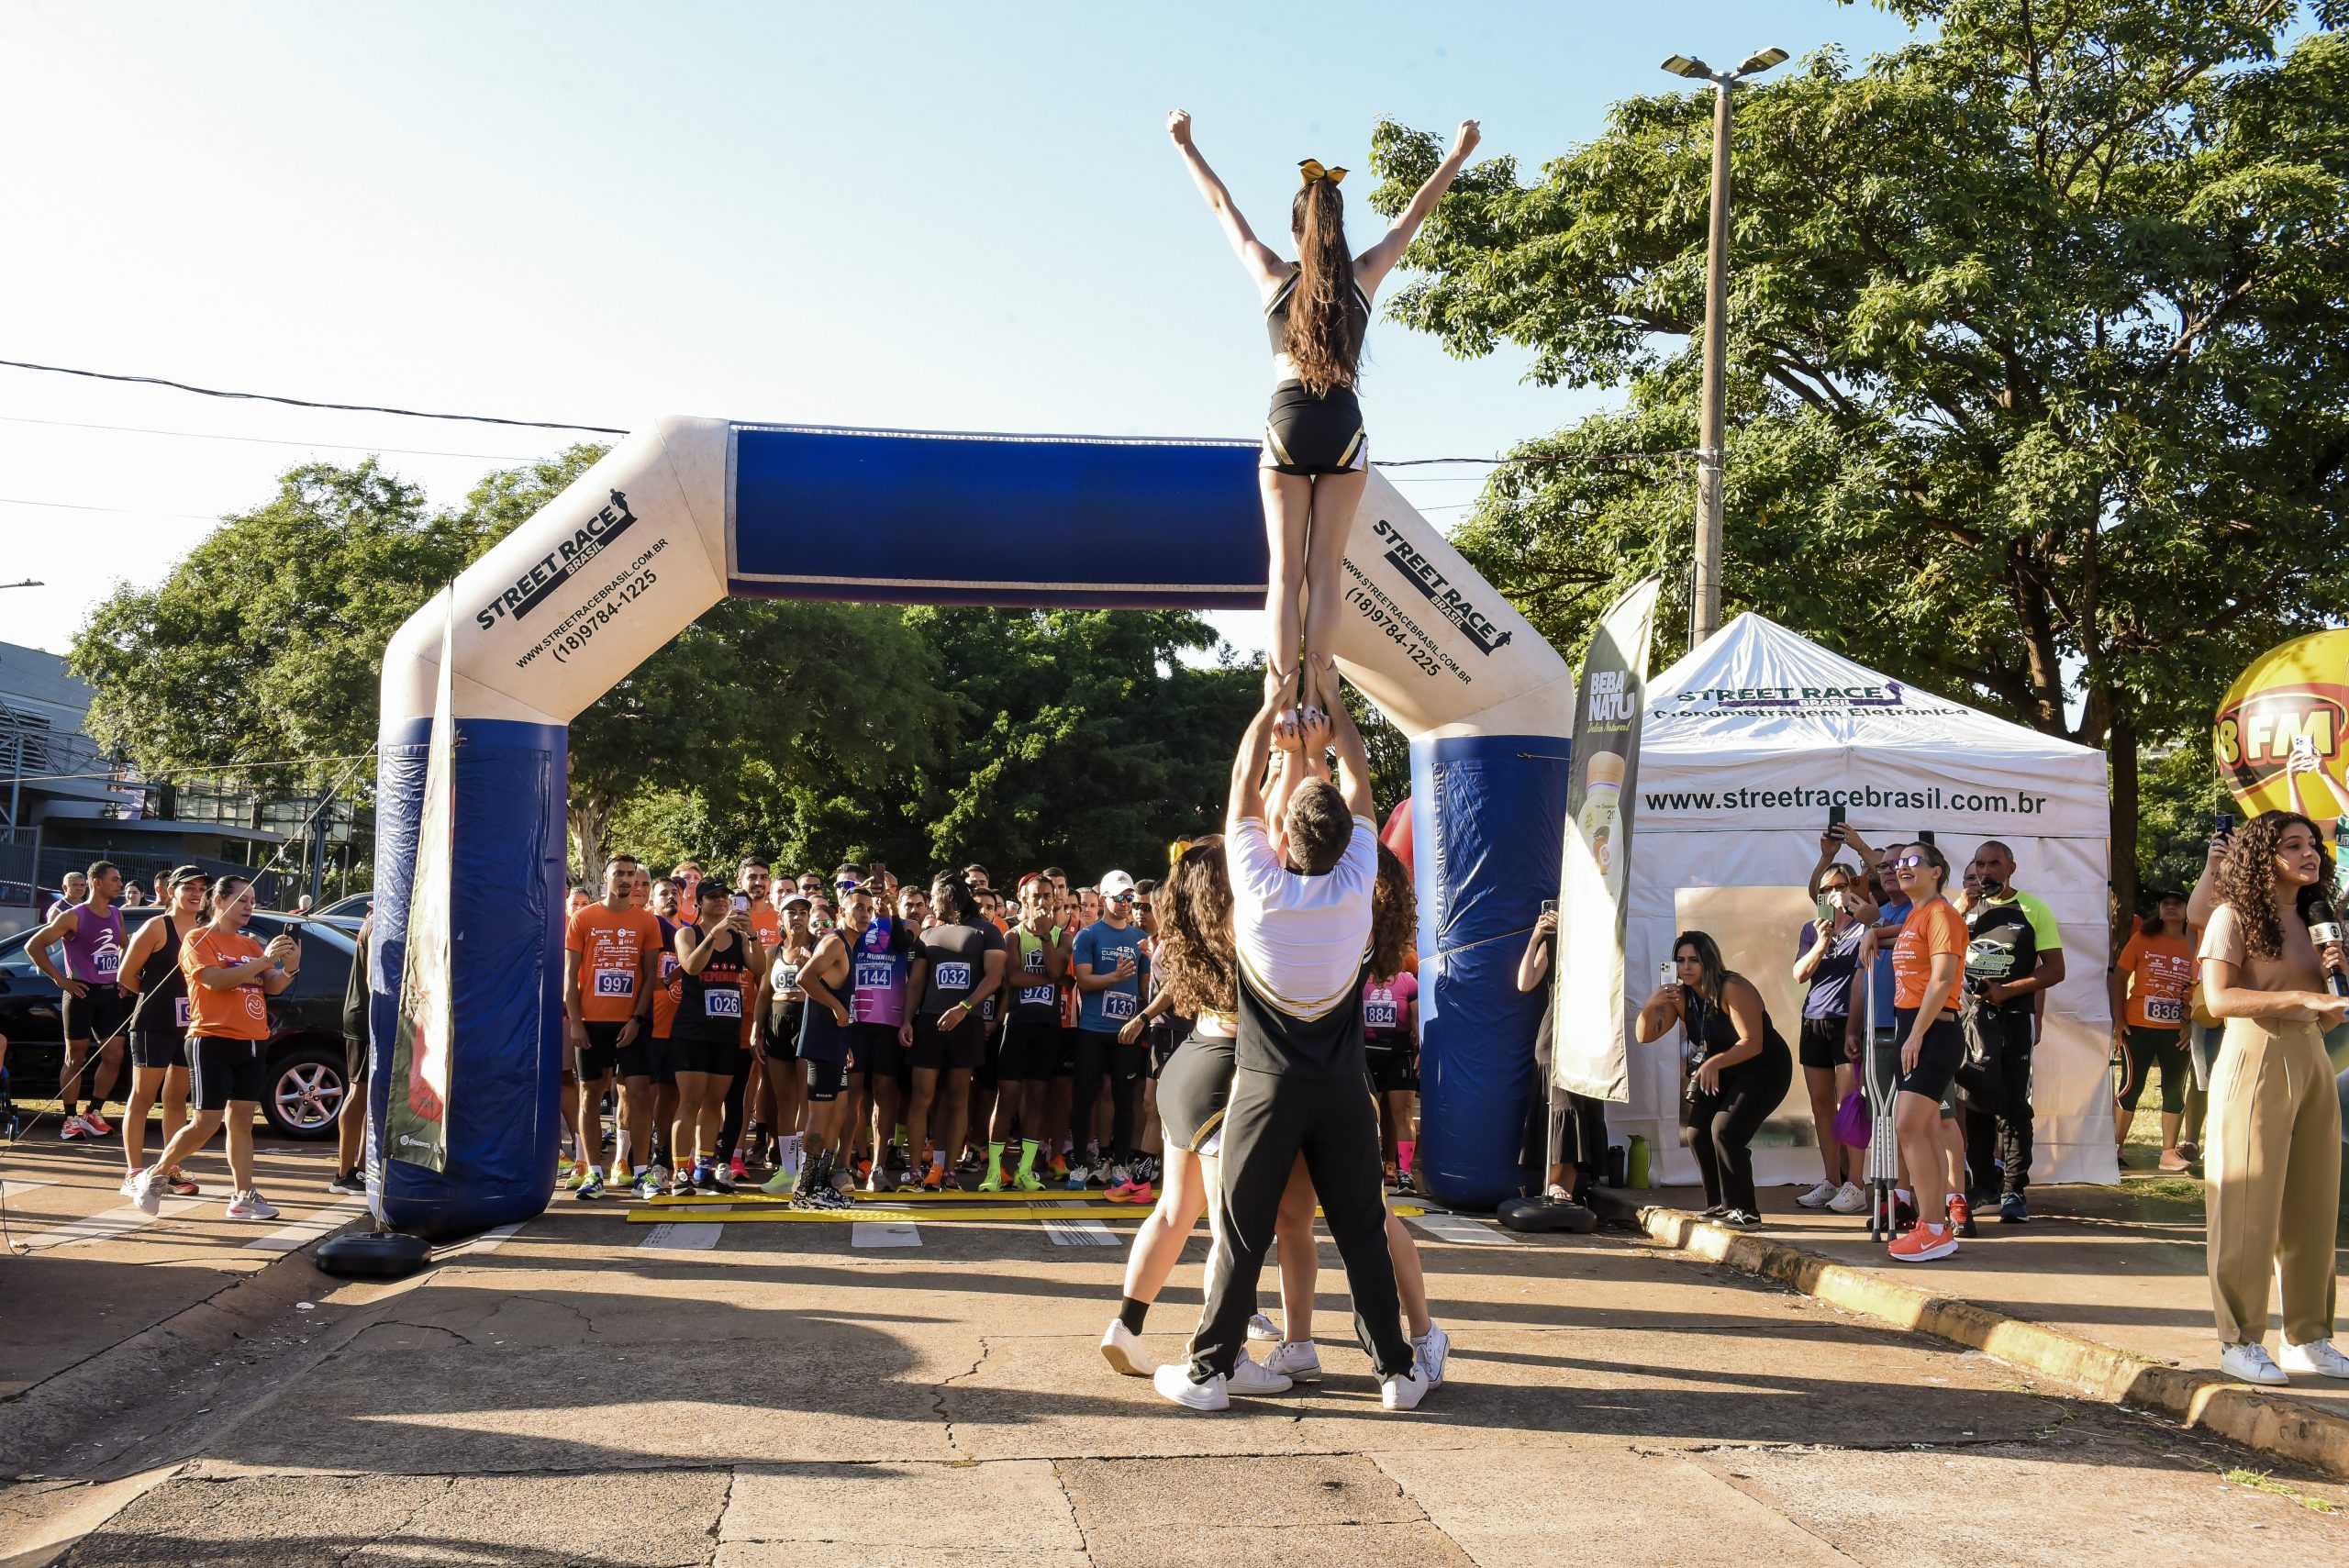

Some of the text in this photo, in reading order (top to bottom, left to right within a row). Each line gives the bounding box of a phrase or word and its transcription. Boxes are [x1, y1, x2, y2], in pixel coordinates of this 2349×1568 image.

[476, 506, 618, 630] STREET RACE
[565, 542, 605, 576] BRASIL
[1372, 519, 1497, 639] STREET RACE
[516, 538, 669, 669] WWW.STREETRACEBRASIL.COM.BR
[1431, 595, 1464, 629] BRASIL
[552, 568, 658, 663] (18)9784-1225
[1345, 587, 1442, 677] (18)9784-1225
[1590, 670, 1625, 695] BEBA
[1676, 686, 1884, 702] STREET RACE
[1798, 698, 1854, 707] BRASIL
[1587, 692, 1635, 721] NATU
[2248, 709, 2332, 760] FM
[1645, 785, 2046, 814] www.streetracebrasil.com.br
[101, 956, 117, 971] 102
[866, 953, 896, 962] RUNNING
[603, 976, 630, 992] 997
[777, 973, 796, 988] 95
[863, 970, 888, 984] 144
[941, 970, 966, 984] 032
[714, 996, 738, 1013] 026
[1110, 998, 1133, 1016] 133
[2152, 1004, 2180, 1019] 836
[1369, 1007, 1393, 1023] 884
